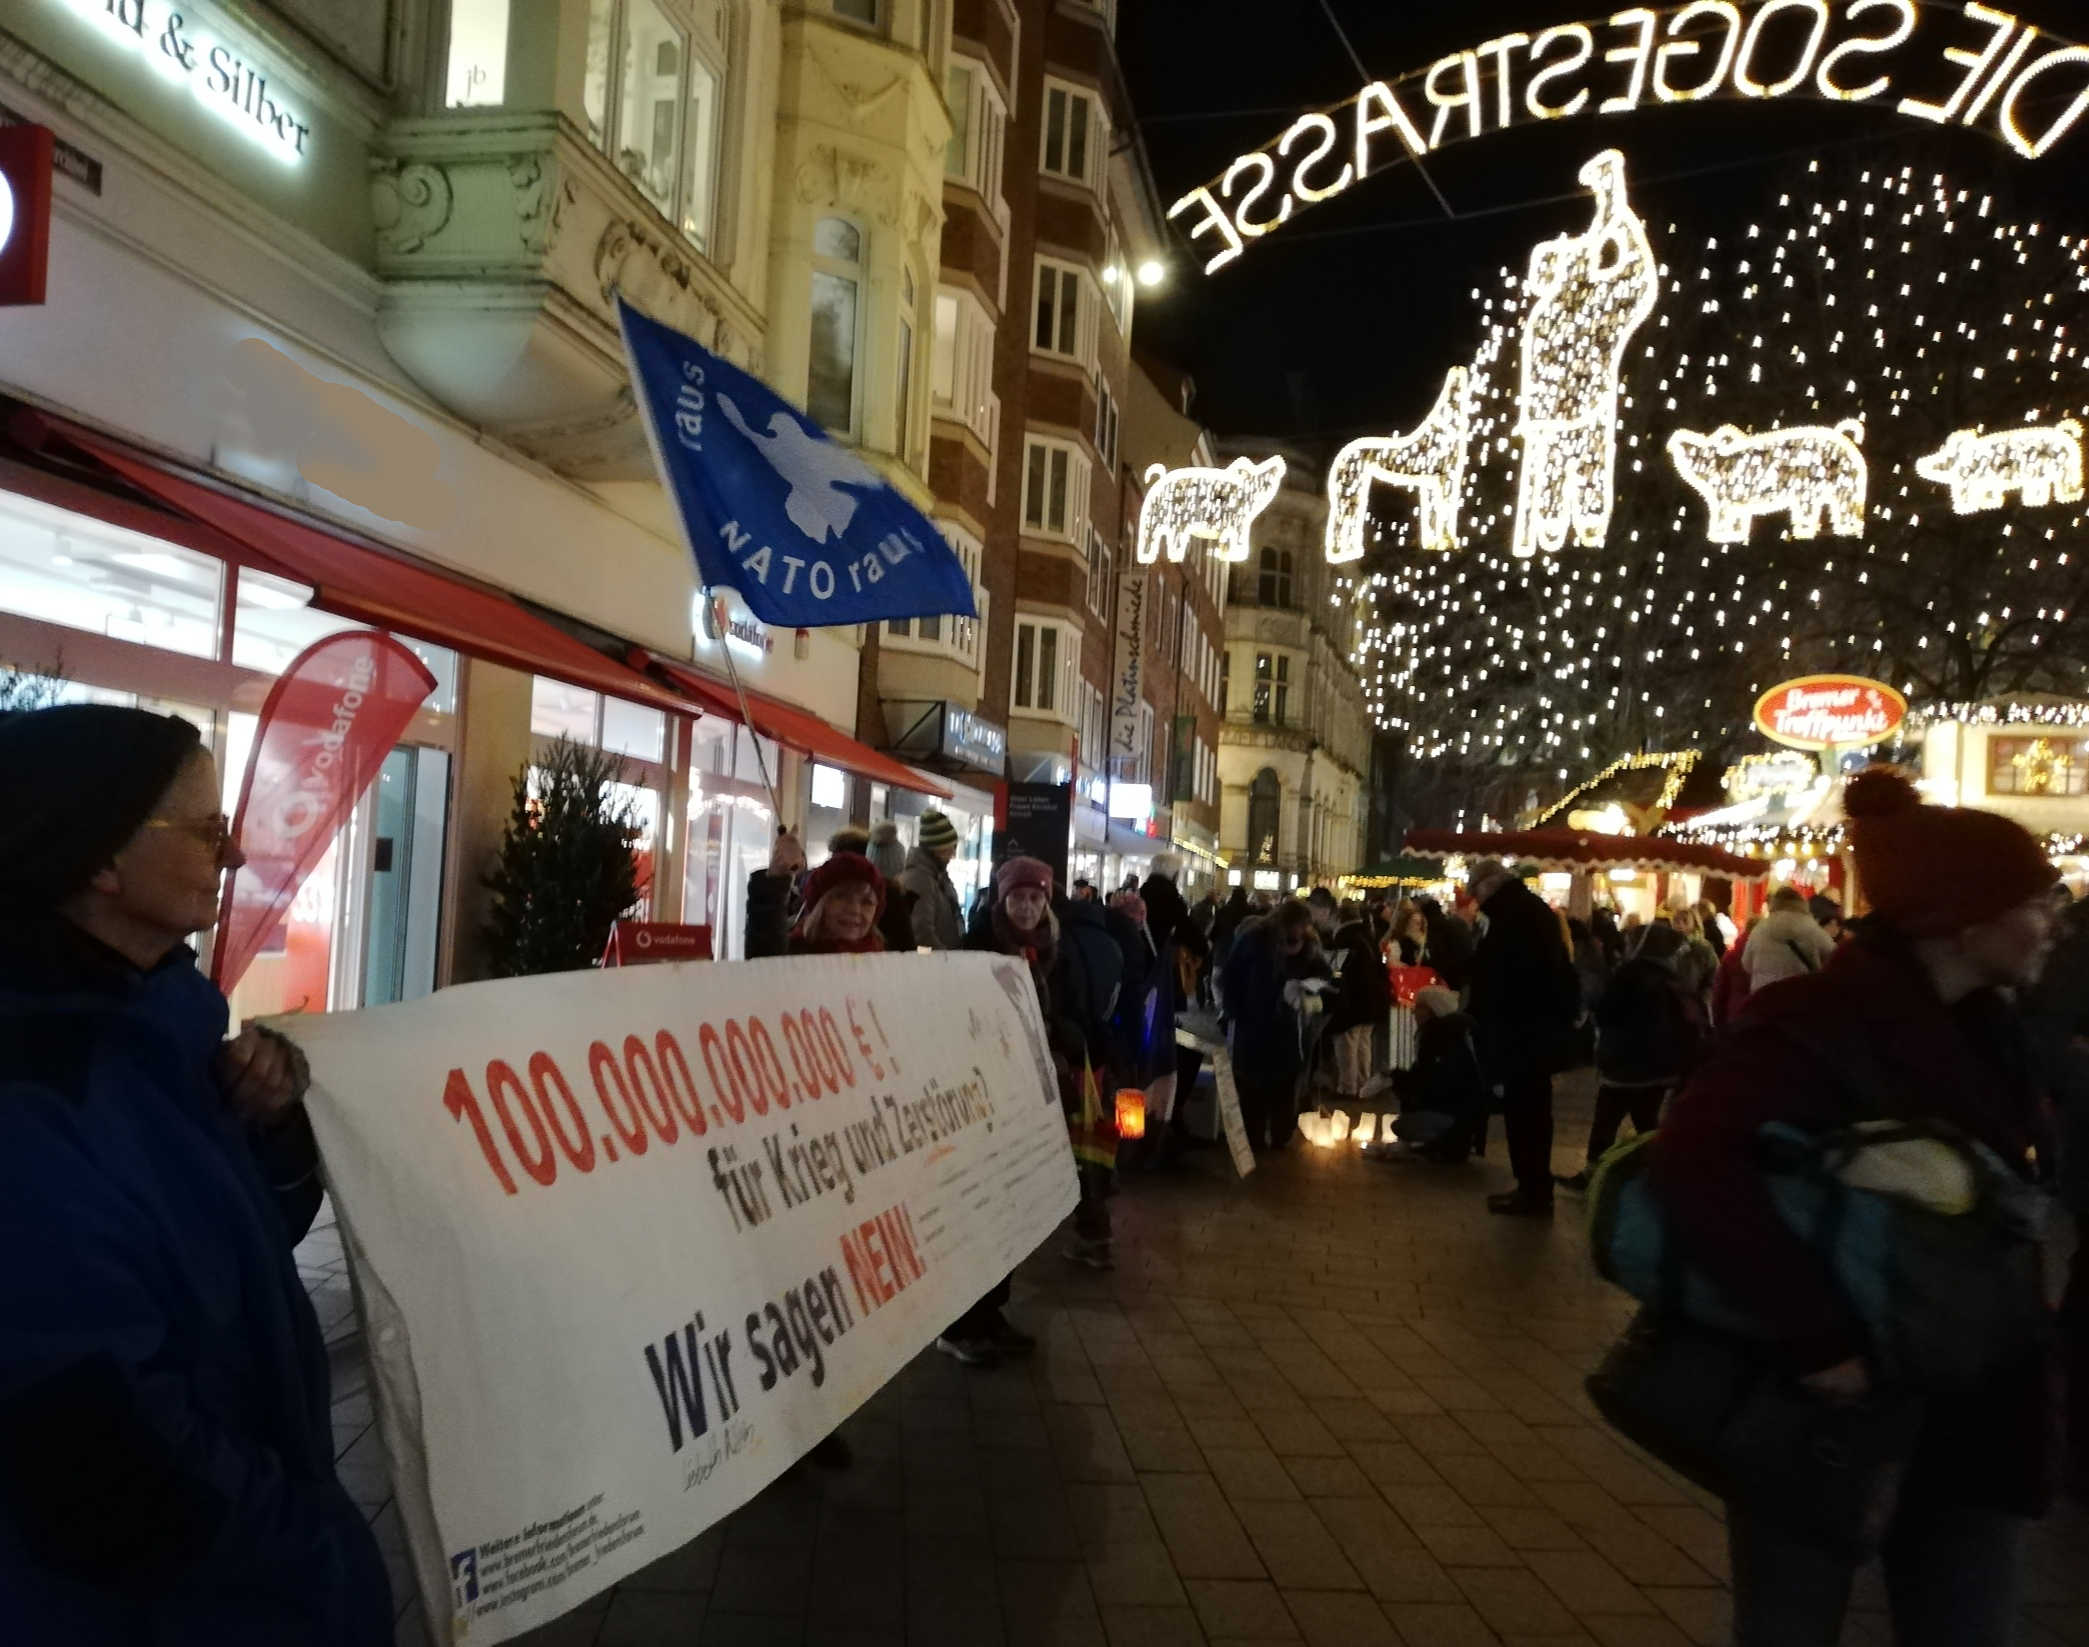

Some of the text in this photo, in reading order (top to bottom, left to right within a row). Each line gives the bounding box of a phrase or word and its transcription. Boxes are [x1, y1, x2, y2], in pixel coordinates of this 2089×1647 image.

[160, 13, 196, 72] &
[207, 46, 310, 156] Silber
[674, 361, 705, 451] raus
[719, 520, 836, 600] NATO
[303, 655, 377, 790] vodafone
[653, 932, 695, 945] vodafone
[441, 1004, 856, 1196] 100.000.000.000
[707, 1145, 773, 1235] für
[762, 1122, 856, 1207] Krieg
[844, 1095, 900, 1176] und
[644, 1200, 928, 1455] Wir sagen NEIN!
